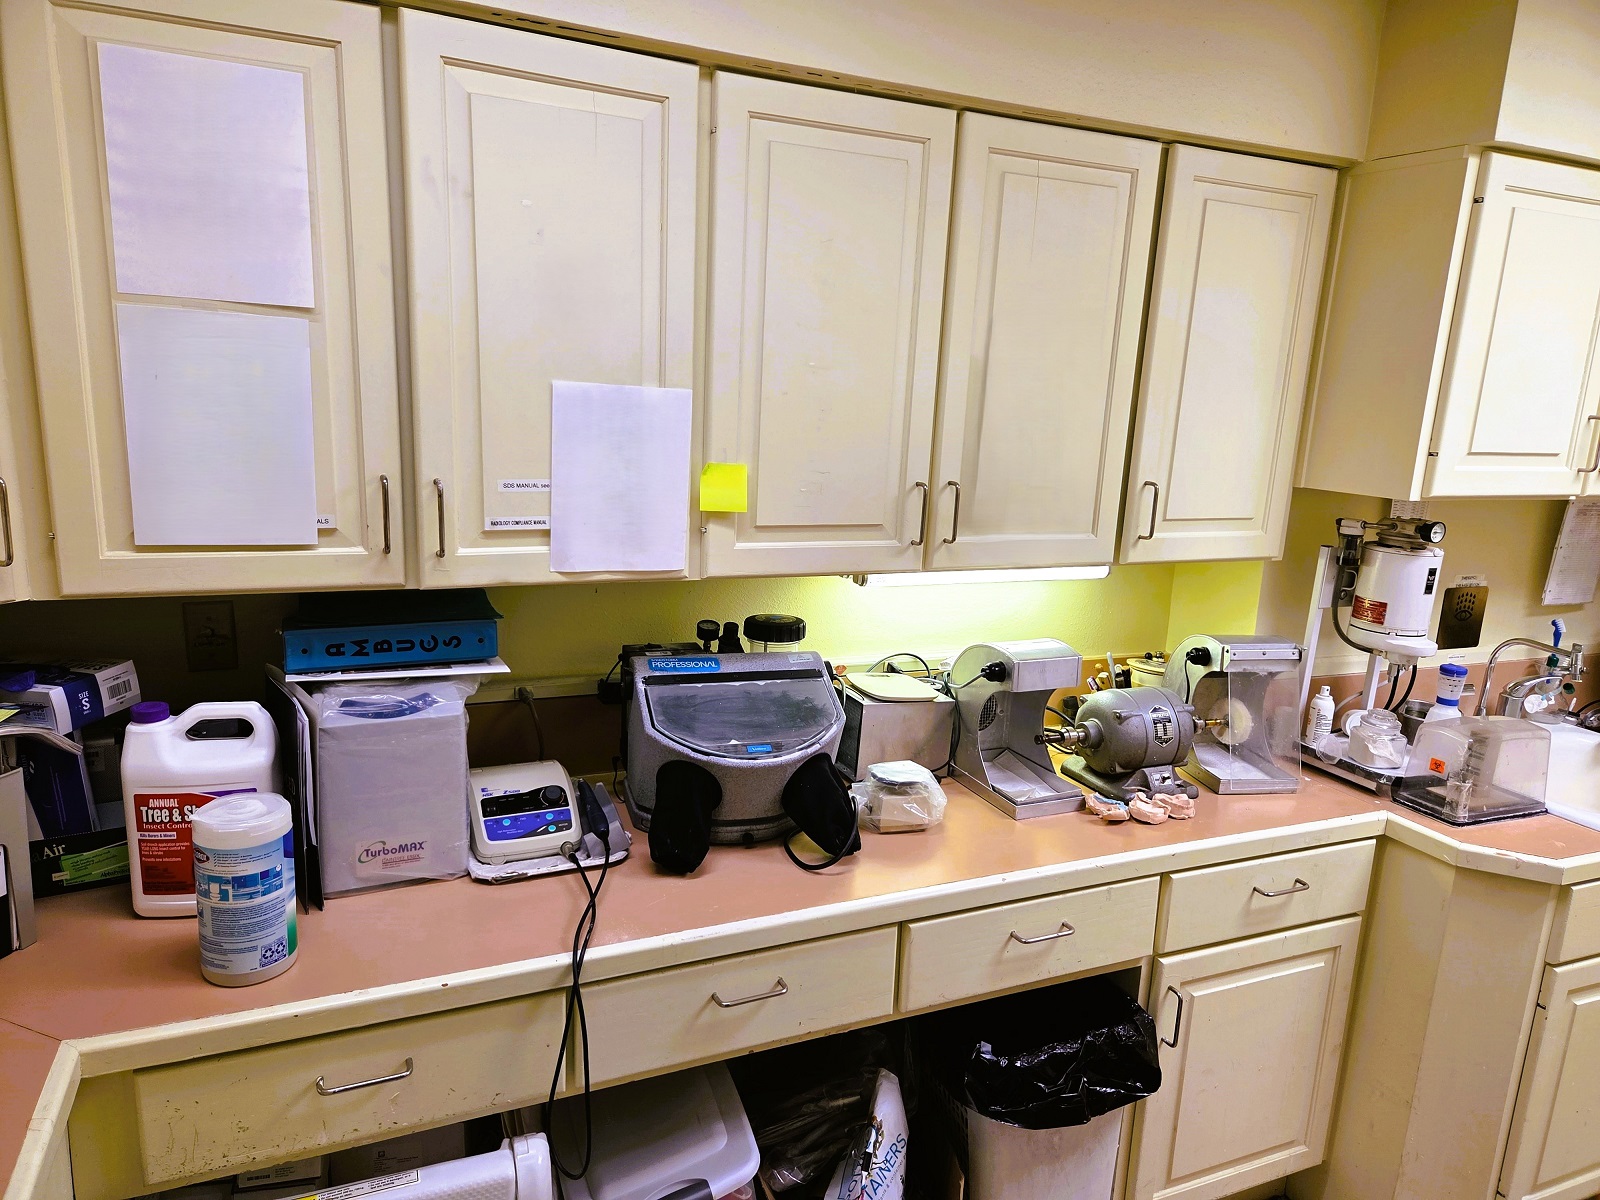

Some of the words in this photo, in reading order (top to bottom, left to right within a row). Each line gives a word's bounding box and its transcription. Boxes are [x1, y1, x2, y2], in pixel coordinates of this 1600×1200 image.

[651, 660, 718, 668] PROFESSIONAL
[78, 690, 90, 700] SIZE
[81, 698, 91, 711] S
[149, 799, 179, 808] ANNUAL
[140, 806, 170, 823] Tree
[172, 807, 182, 822] &
[364, 841, 425, 858] TurboMAX
